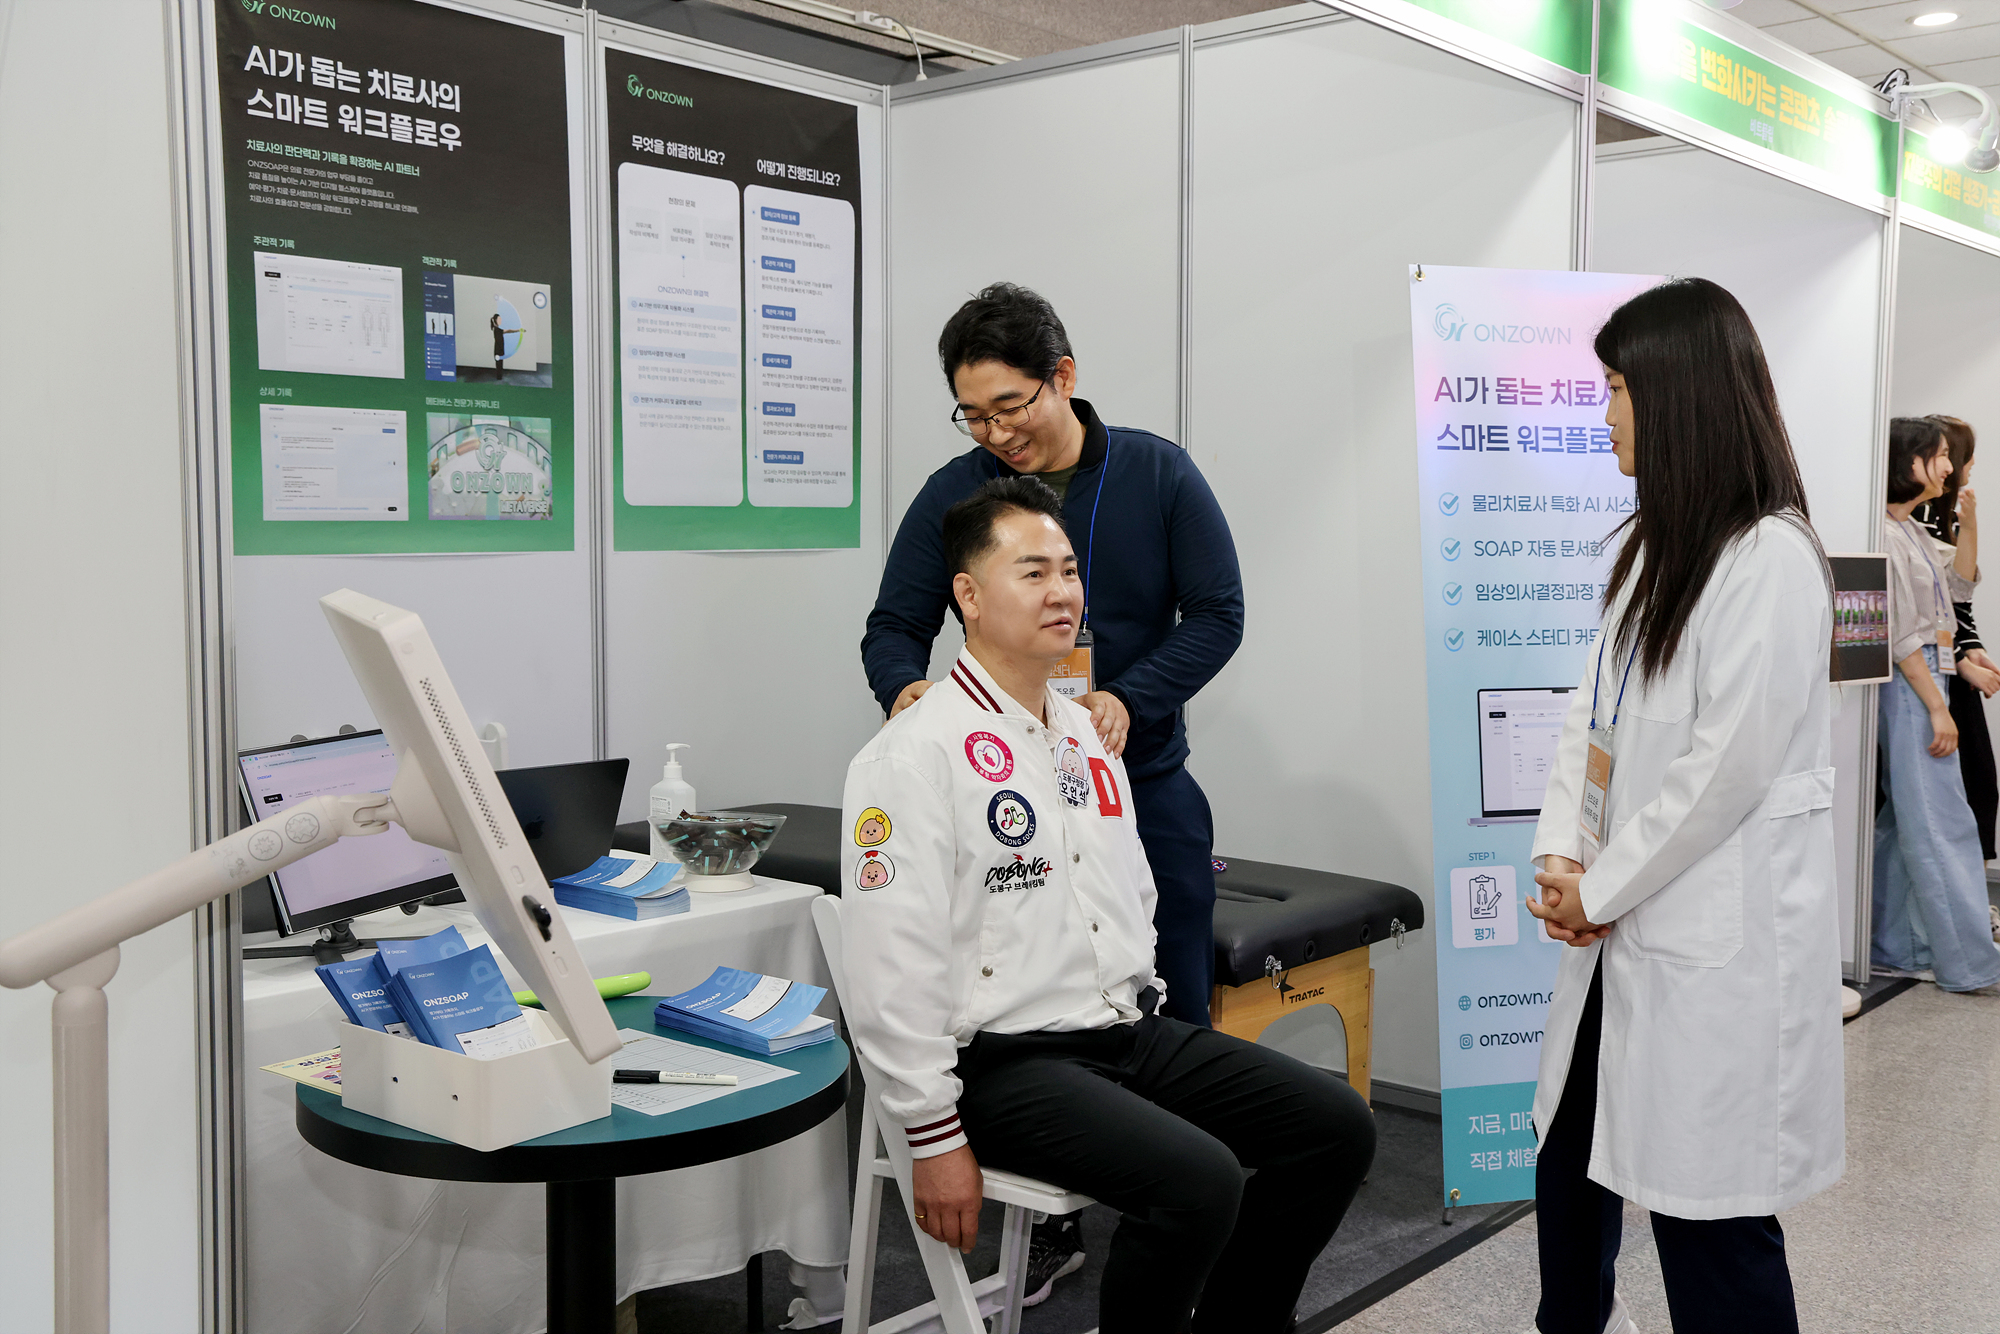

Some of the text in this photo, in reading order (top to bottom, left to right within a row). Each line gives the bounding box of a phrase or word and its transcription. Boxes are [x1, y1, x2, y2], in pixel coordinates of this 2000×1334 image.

[269, 5, 336, 31] ONZOWN
[244, 45, 461, 113] AI가 돕는 치료사의
[646, 88, 693, 108] ONZOWN
[1701, 46, 1777, 118] 변화시키는
[1779, 84, 1821, 137] 콘텐츠
[247, 88, 462, 152] 스마트 워크플로우
[246, 139, 420, 178] 치료사의 판단력과 기록을 확장하는 AI 파트너
[632, 134, 725, 166] 무엇을 해결하나요?
[757, 159, 841, 187] 어떻게 진행되나요?
[1943, 168, 1962, 201] 리얼
[253, 236, 295, 249] 주관적 기록
[422, 256, 457, 268] 객관적 기록
[1474, 324, 1571, 345] ONZOWN
[259, 387, 293, 397] 상세 기록
[1434, 376, 1489, 405] AI가
[1495, 377, 1543, 406] 돕는
[454, 398, 474, 408] 전문가
[475, 399, 500, 409] 커뮤니티
[1437, 424, 1510, 452] 스마트
[450, 470, 533, 494] ONZOWN
[501, 500, 548, 514] METAVERSE
[1472, 494, 1638, 513] 물리치료사 특화 AI 시스
[1474, 540, 1604, 558] SOAP 자동 문서화
[1475, 583, 1594, 601] 임상의사결정과정
[1477, 629, 1523, 647] 케이스
[1526, 629, 1571, 646] 스터디
[996, 792, 1015, 802] SEOUL
[1088, 757, 1122, 817] D
[994, 823, 1035, 846] DOBONG SOCKS
[1468, 852, 1496, 861] STEP 1
[984, 856, 1046, 888] DOBONG
[989, 883, 1012, 894] 도봉구
[1474, 927, 1496, 941] 평가
[423, 991, 469, 1007] ONZSOAP
[1288, 987, 1325, 1004] TRATAC
[1468, 1114, 1505, 1135] 지금,
[1470, 1147, 1538, 1172] 직접 체험
